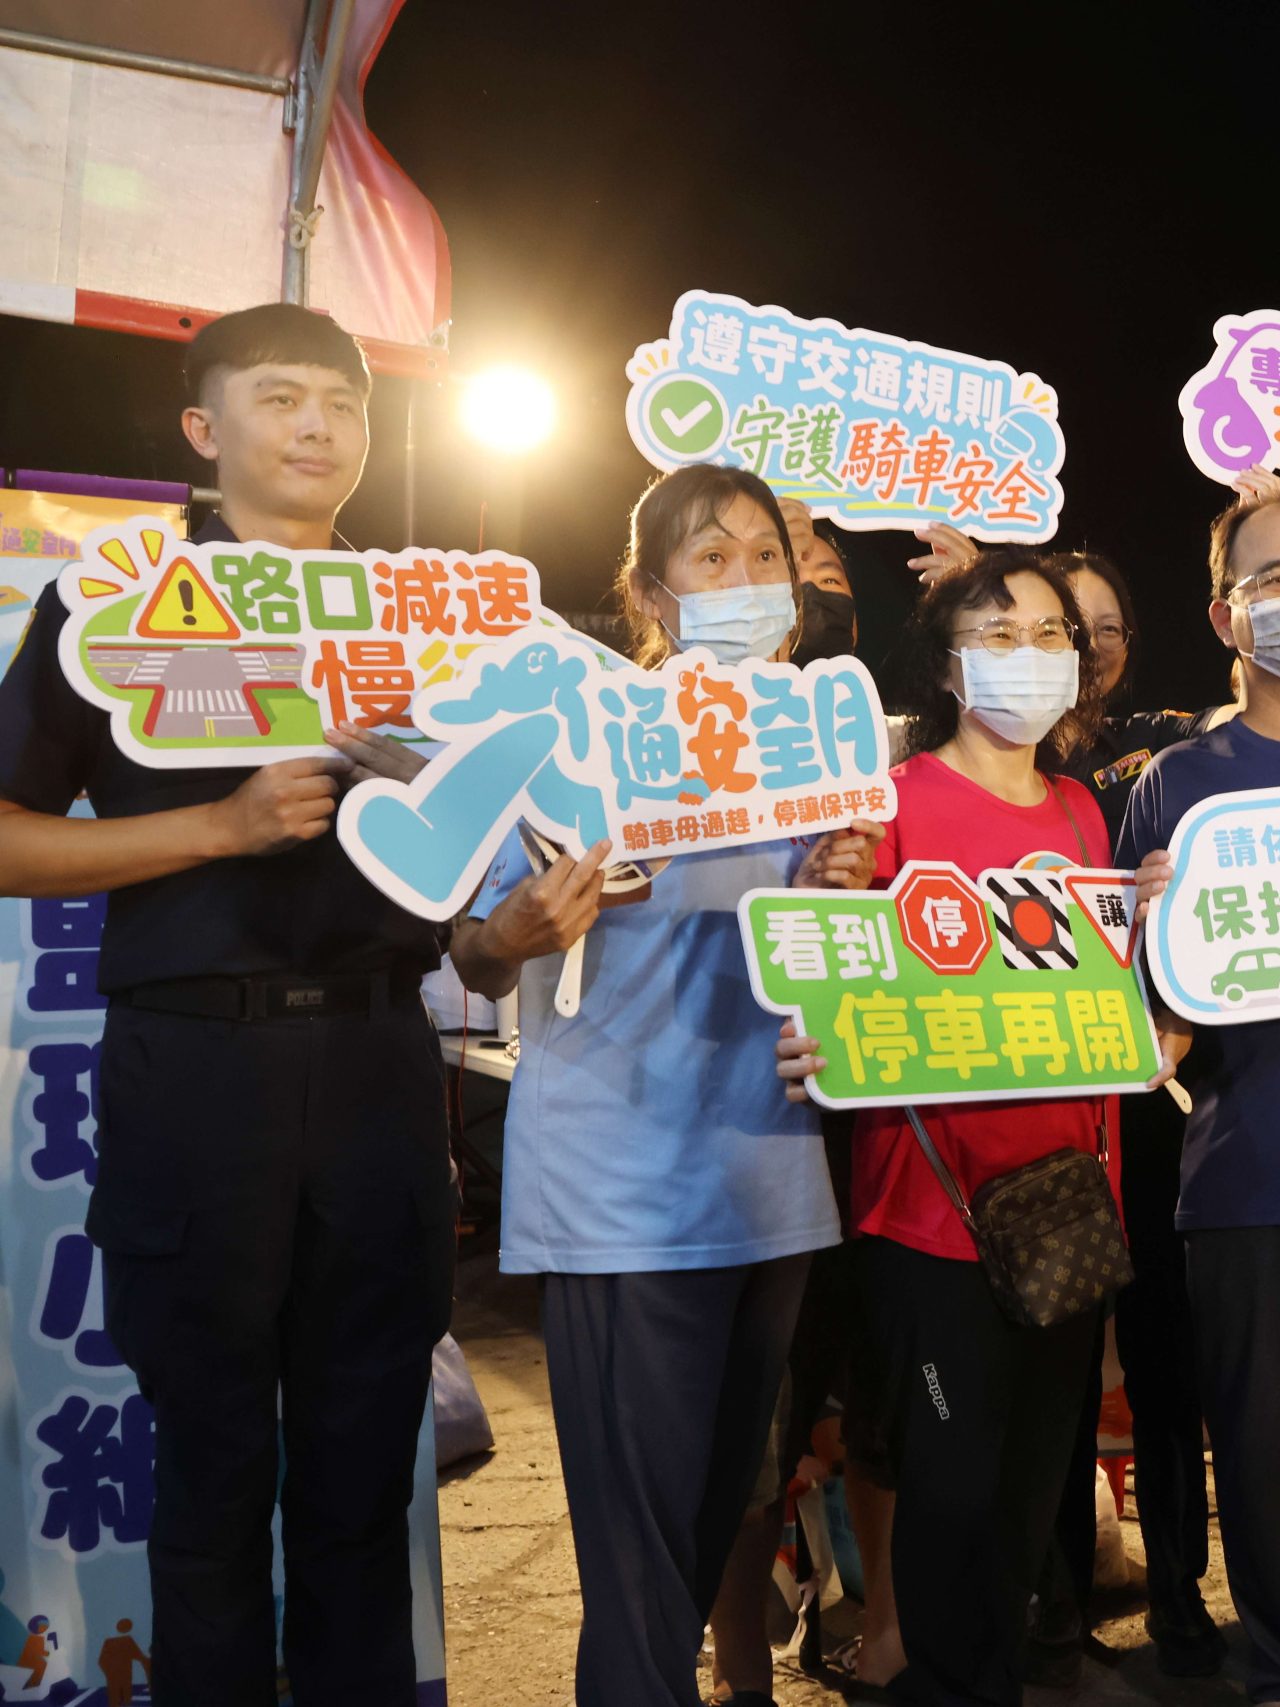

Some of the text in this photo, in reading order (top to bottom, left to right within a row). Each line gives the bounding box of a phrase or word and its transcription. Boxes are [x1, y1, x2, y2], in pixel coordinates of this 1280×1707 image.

[687, 309, 1001, 434] 遵守交通規則
[731, 399, 1047, 523] 守護騎車安全
[211, 553, 532, 637] 路口減速
[764, 910, 898, 982] 看到
[920, 895, 969, 949] 停
[1096, 893, 1129, 928] 讓
[833, 988, 1140, 1086] 停車再開
[922, 1363, 950, 1420] Kappa
